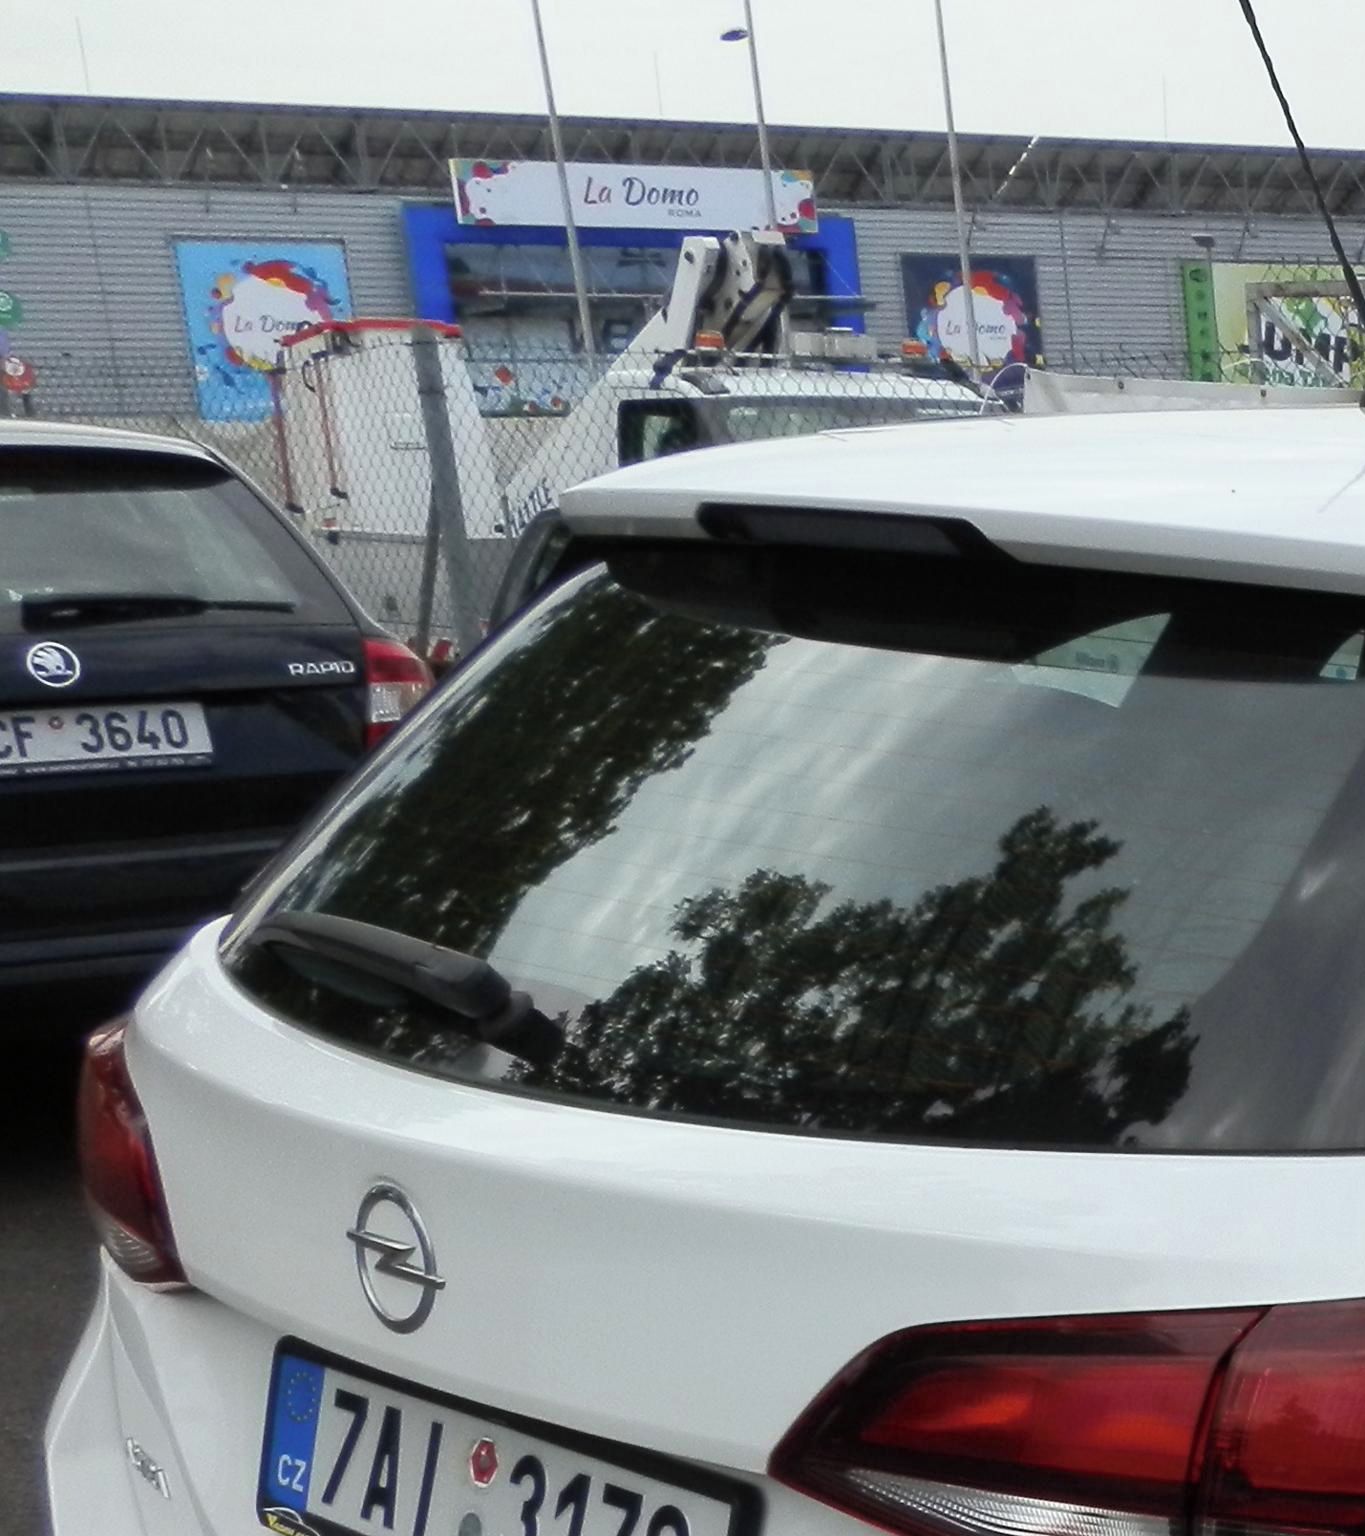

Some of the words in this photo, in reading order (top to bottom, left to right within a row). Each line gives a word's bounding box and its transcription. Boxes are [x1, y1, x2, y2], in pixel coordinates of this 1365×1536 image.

[584, 176, 612, 205] La
[622, 176, 700, 206] Domo
[288, 660, 356, 677] RAPID
[76, 709, 189, 755] 3640
[277, 1453, 307, 1492] CZ
